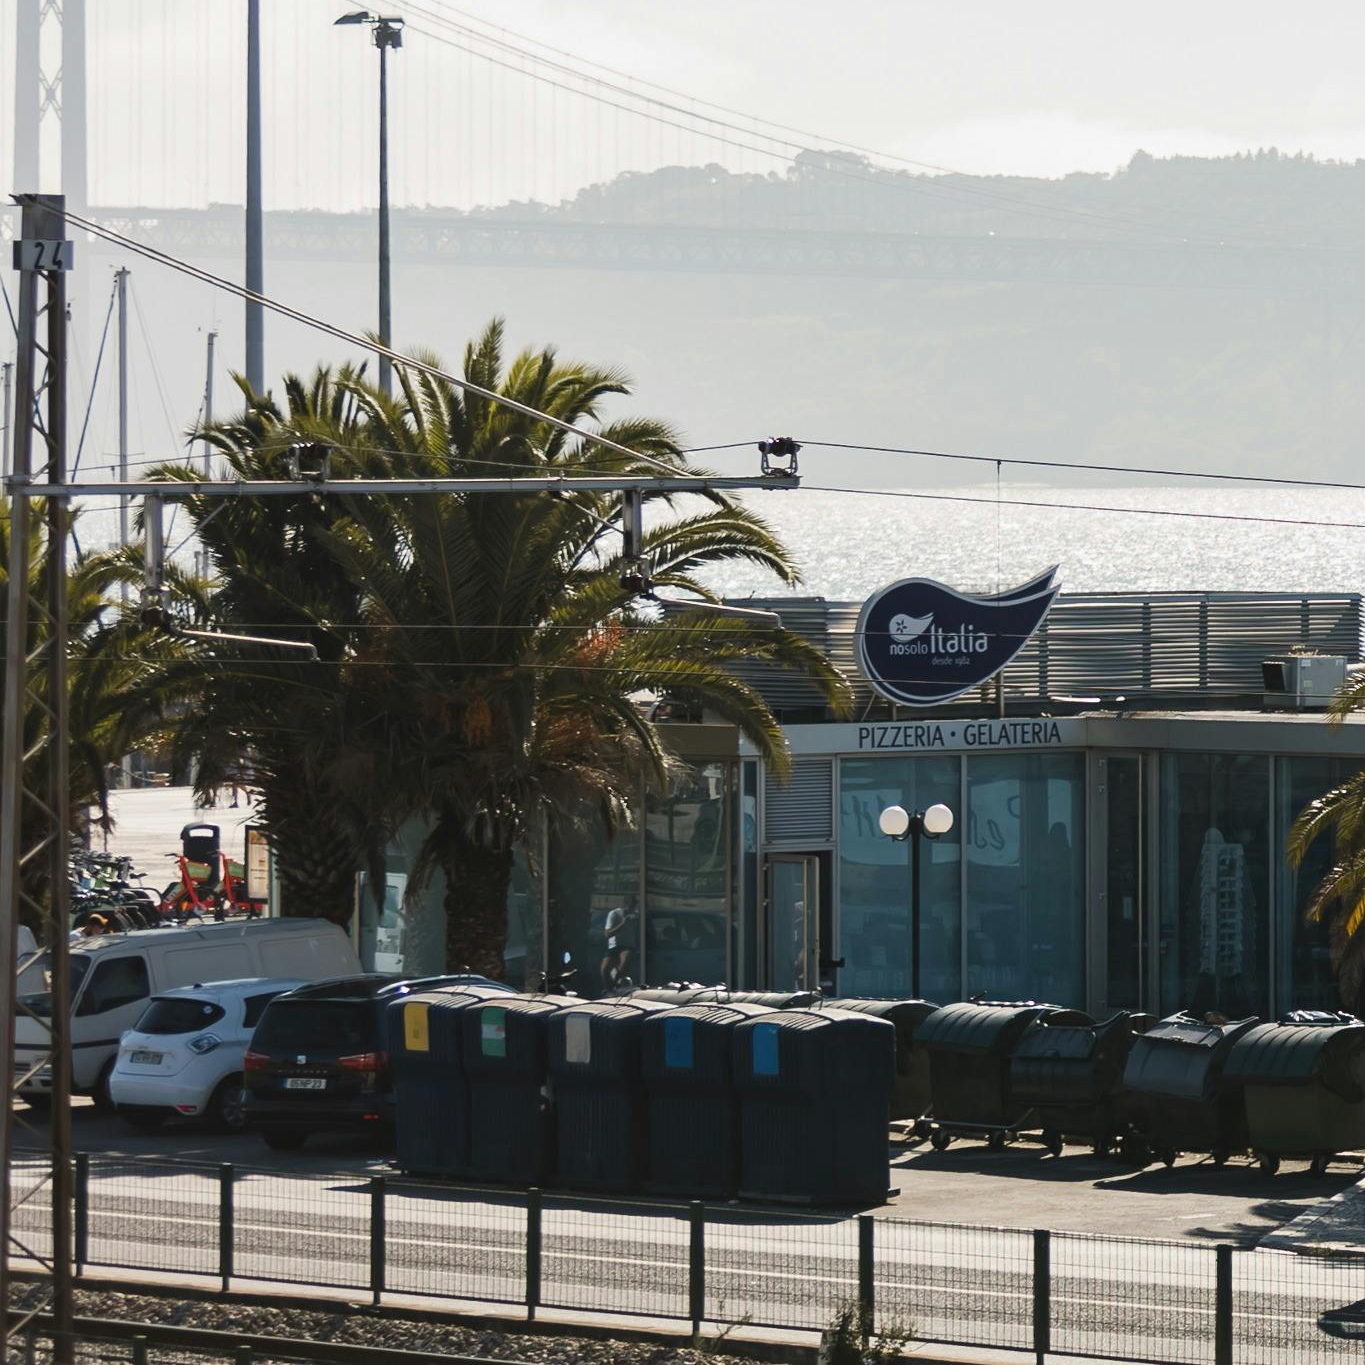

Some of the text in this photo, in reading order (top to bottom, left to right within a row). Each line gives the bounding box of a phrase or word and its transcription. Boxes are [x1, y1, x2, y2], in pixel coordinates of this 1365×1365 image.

[890, 623, 988, 655] nosolo Italia
[932, 656, 953, 665] desde
[858, 722, 1062, 749] PIZZERIA GELATERIA
